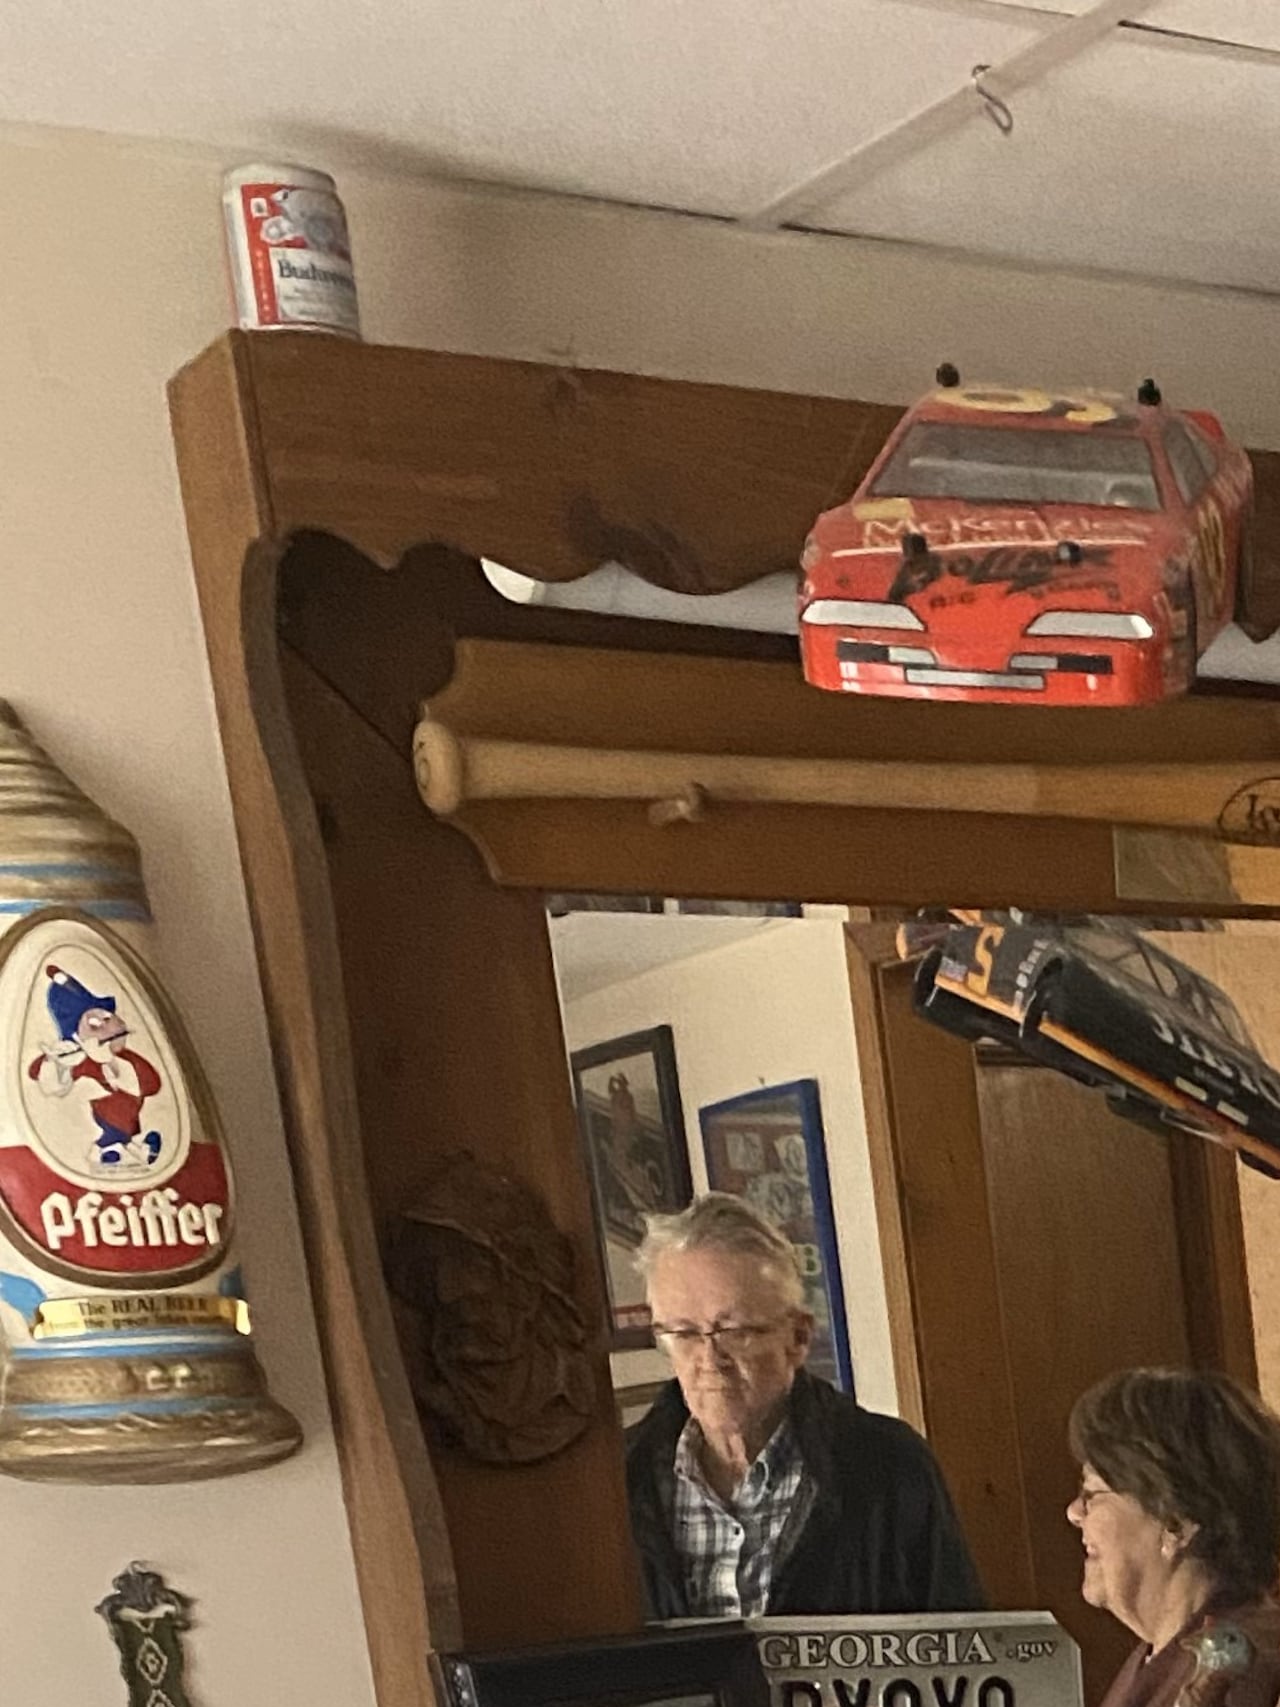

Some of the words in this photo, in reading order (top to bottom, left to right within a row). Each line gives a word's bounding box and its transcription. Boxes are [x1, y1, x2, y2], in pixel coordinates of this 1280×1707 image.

[40, 1187, 224, 1250] Pfeiffer
[78, 1302, 107, 1317] The
[113, 1299, 157, 1314] REAL
[757, 1630, 996, 1671] GEORGIA
[1006, 1640, 1057, 1661] .gov
